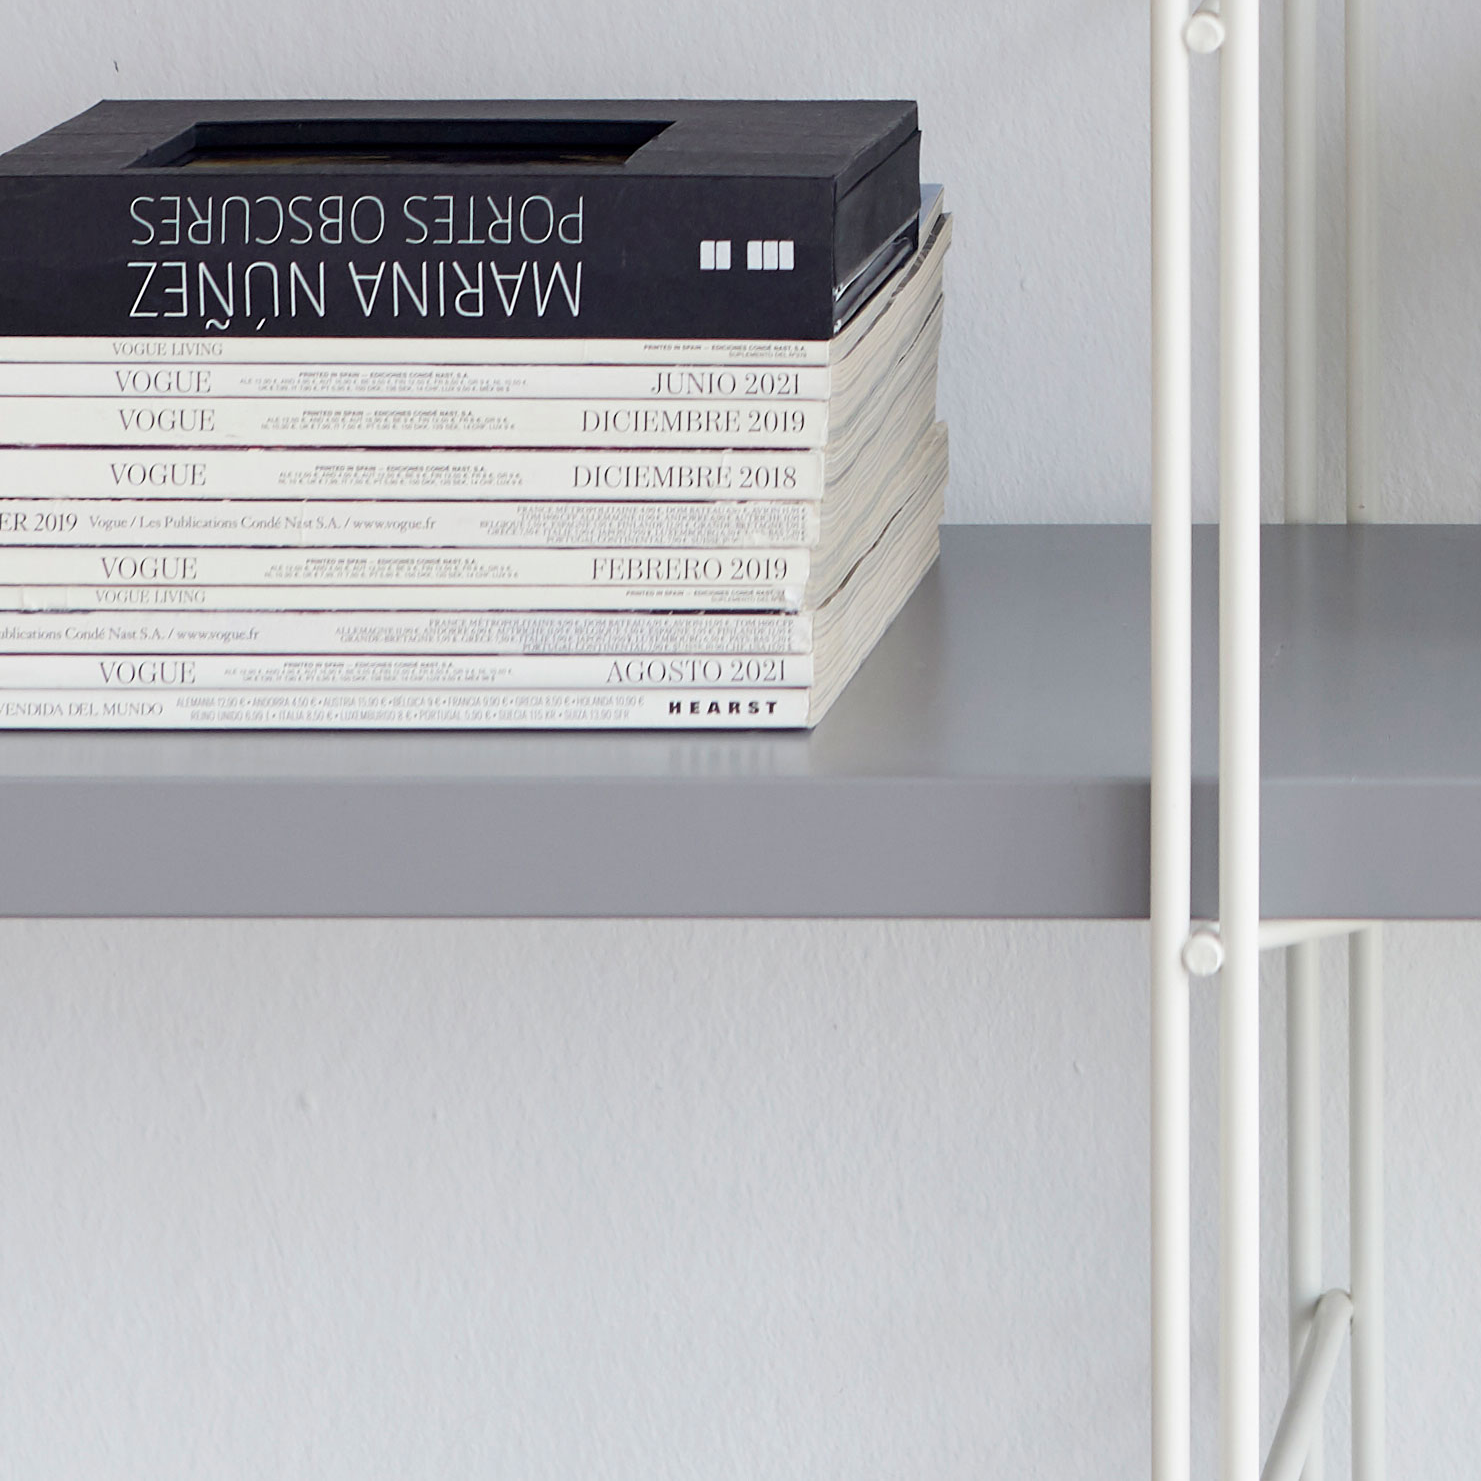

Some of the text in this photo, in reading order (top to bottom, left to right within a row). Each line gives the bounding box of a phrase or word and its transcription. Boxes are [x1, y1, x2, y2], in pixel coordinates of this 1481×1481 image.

[129, 195, 584, 246] PORTES OBSCURES
[126, 260, 583, 331] MARINA NÚÑEZ
[112, 342, 223, 356] VOGUE LIVING
[115, 370, 211, 394] VOGUE
[651, 371, 800, 396] JUNIO 2021
[118, 408, 215, 432] VOGUE
[581, 409, 805, 433] DICIEMBRE 2019
[110, 463, 207, 486] VOGUE
[573, 465, 797, 489] DICIEMBRE 2018
[33, 512, 78, 532] 2019
[89, 515, 127, 531] Vogue
[140, 516, 161, 528] Les
[164, 515, 238, 529] Publications
[241, 515, 281, 529] Condé
[353, 517, 437, 532] www.vogue.fr
[101, 556, 198, 580] VOGUE
[592, 557, 788, 581] FEBRERO 2019
[95, 589, 206, 604] VOGUE LIVING
[65, 626, 105, 640] Condé
[108, 627, 137, 640] Nast
[176, 627, 260, 643] www.vogue.fr
[100, 661, 197, 684] VOGUE
[606, 659, 786, 684] AGOSTO 2021
[68, 702, 99, 716] DEL
[102, 702, 164, 716] MUNDO
[668, 700, 778, 715] HEARST
